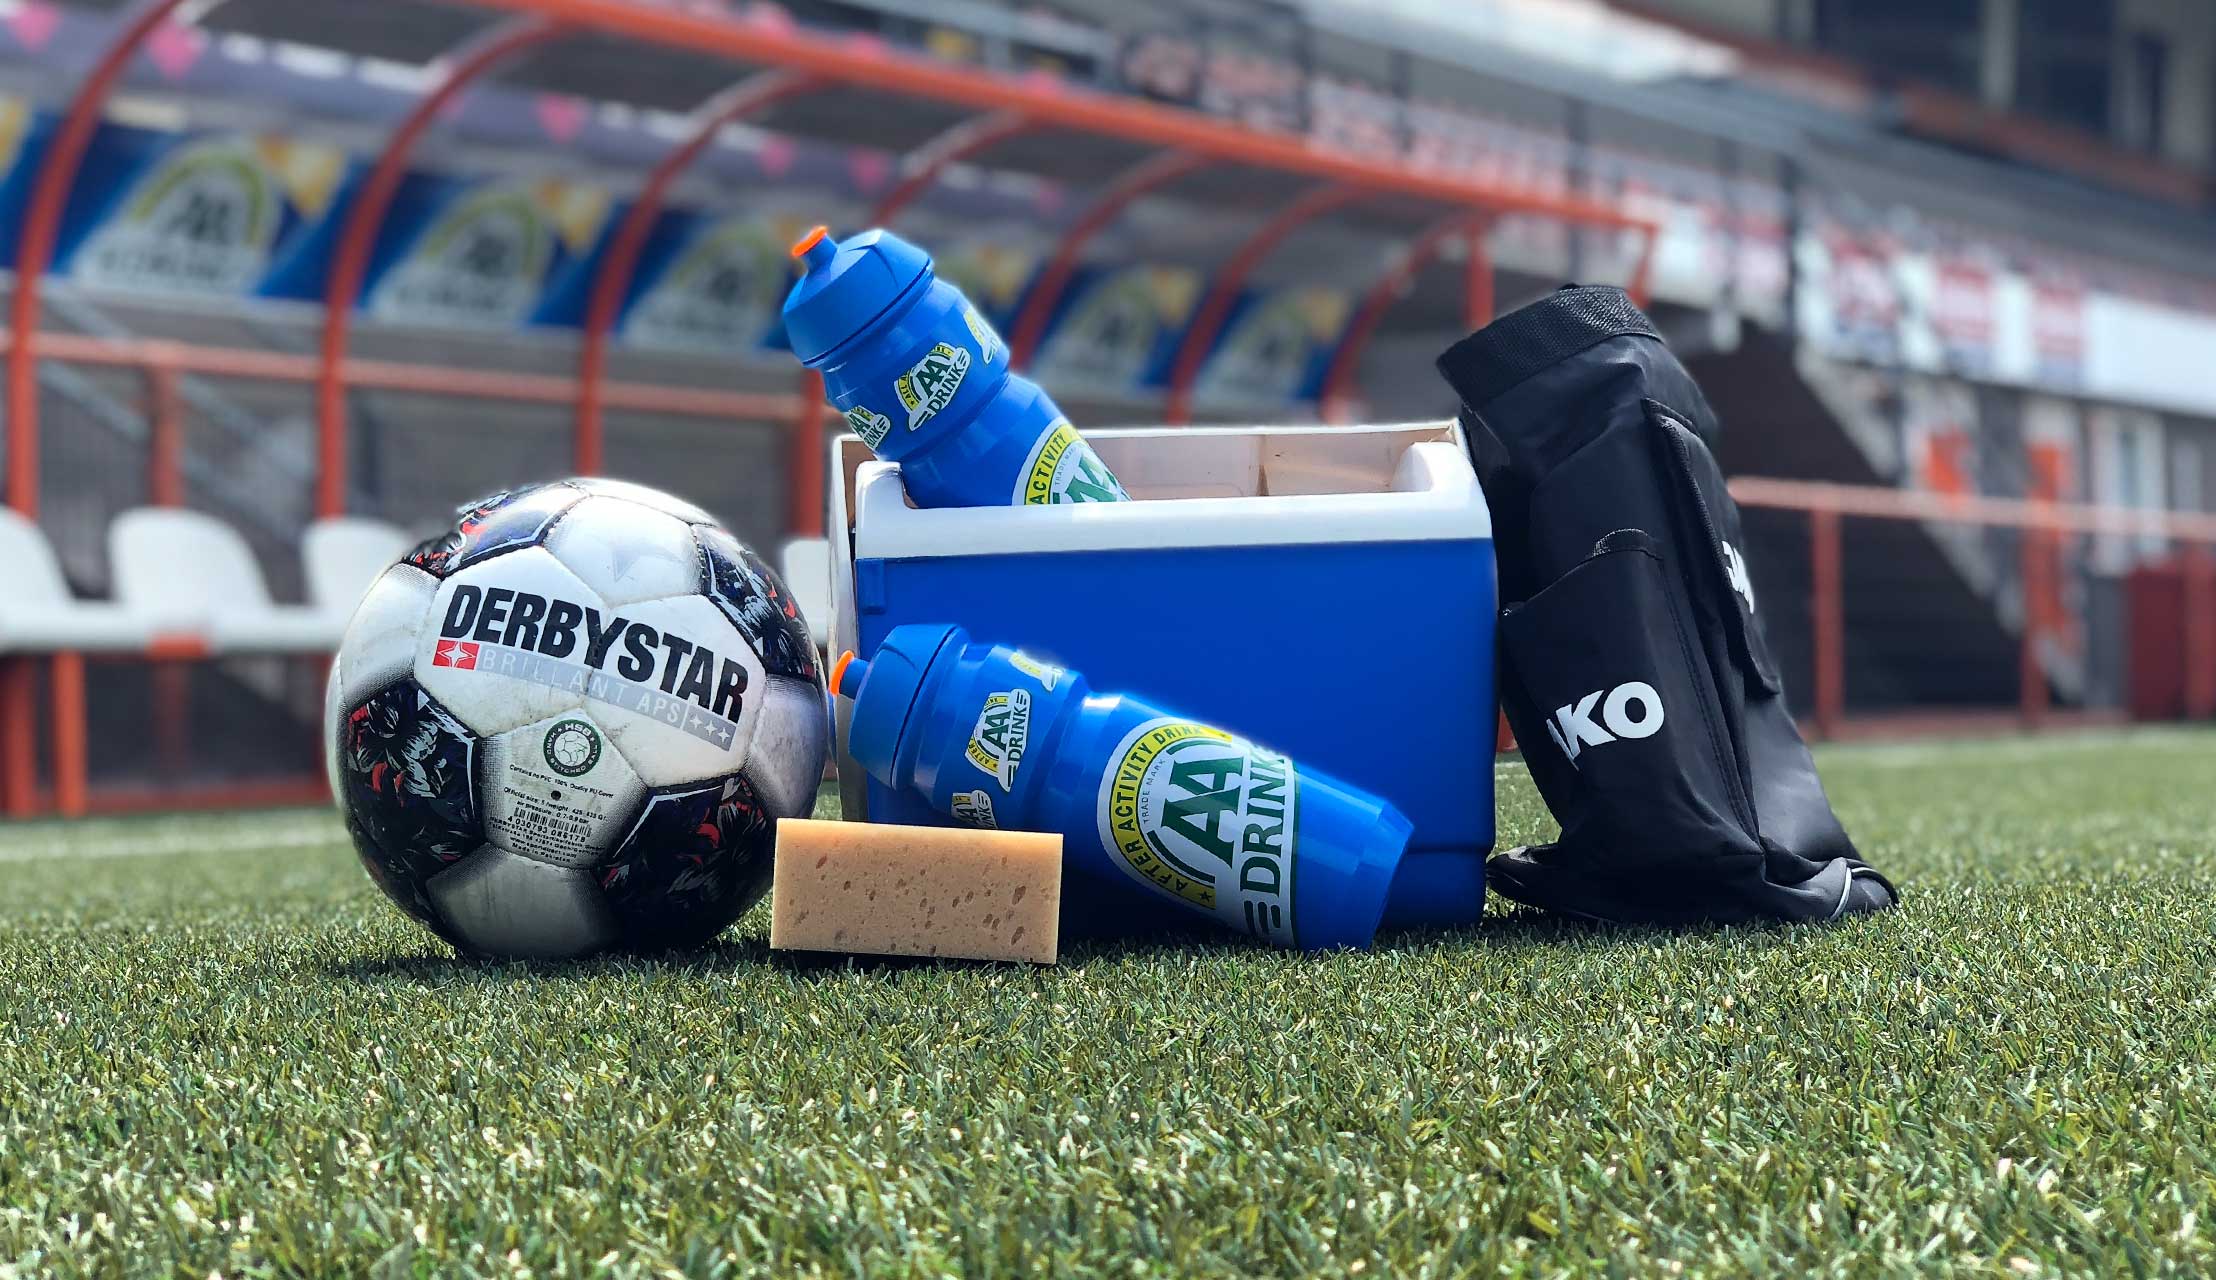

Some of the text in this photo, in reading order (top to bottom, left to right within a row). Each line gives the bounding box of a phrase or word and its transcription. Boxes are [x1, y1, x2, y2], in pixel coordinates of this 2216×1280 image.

[916, 359, 951, 399] AA
[927, 362, 965, 413] DRINK
[1029, 432, 1067, 505] ACTIVITY
[440, 584, 748, 724] DERBYSTAR
[483, 646, 682, 724] BRILLANT APS
[565, 723, 591, 737] HSB
[982, 711, 1011, 753] AA
[1007, 705, 1028, 761] DRINK
[1115, 743, 1154, 833] ACTIVITY
[1148, 759, 1166, 785] MARK
[1161, 757, 1244, 869] AA
[1240, 750, 1286, 897] DRINK
[1125, 838, 1189, 893] AFTER
